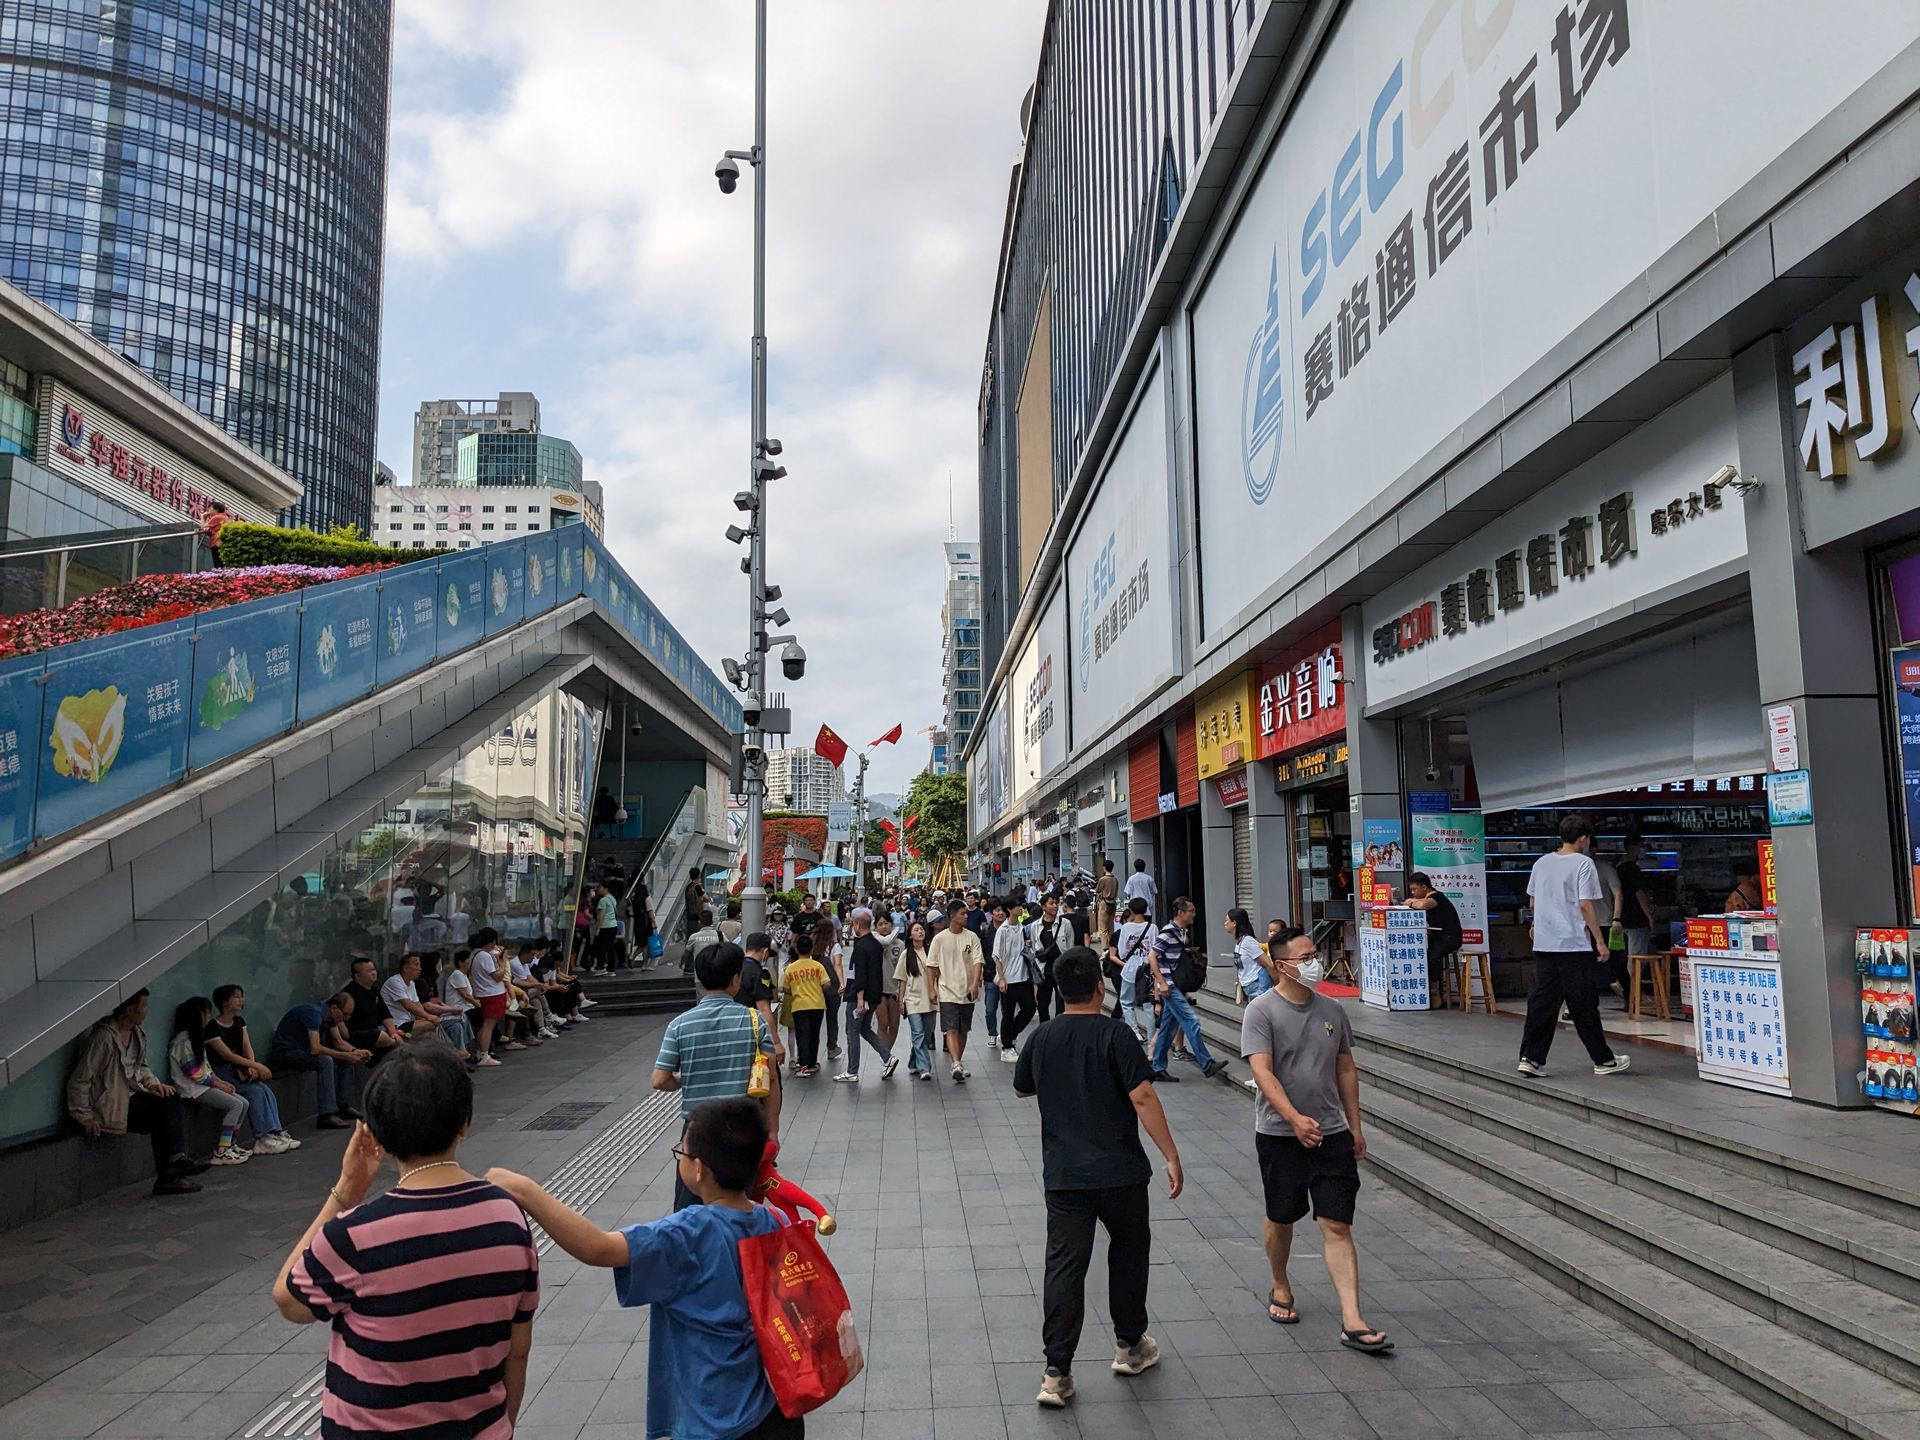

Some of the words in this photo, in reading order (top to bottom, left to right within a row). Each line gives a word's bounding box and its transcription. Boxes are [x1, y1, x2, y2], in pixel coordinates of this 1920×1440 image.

[1305, 0, 1631, 421] 赛格通信市场
[1793, 272, 1920, 482] 利
[1440, 491, 1637, 636] 赛格通信市场
[1093, 558, 1150, 664] 赛格通信市场
[265, 644, 289, 664] 文明出行
[266, 660, 291, 679] 平安回家
[146, 679, 180, 704] 关爱孩子
[1260, 647, 1337, 737] 金兴音响
[148, 698, 182, 723] 情系未来
[1361, 867, 1374, 902] 高价回收
[1388, 933, 1424, 945] 移动靓号
[1389, 948, 1425, 960] 联通靓号
[1709, 934, 1727, 947] 103G
[1391, 963, 1425, 975] 上网卡
[1391, 978, 1427, 990] 电信靓号
[1701, 968, 1736, 985] 手机维修
[1739, 971, 1778, 989] 手机贴膜
[1391, 994, 1405, 1005] 4G
[1408, 993, 1427, 1005] 设备
[1702, 990, 1713, 1057] 全球通靓号
[1712, 990, 1724, 1060] 移动靓号
[1724, 990, 1735, 1061] 联通靓号
[1735, 992, 1747, 1063] 电信靓号
[1761, 994, 1773, 1068] 上网卡
